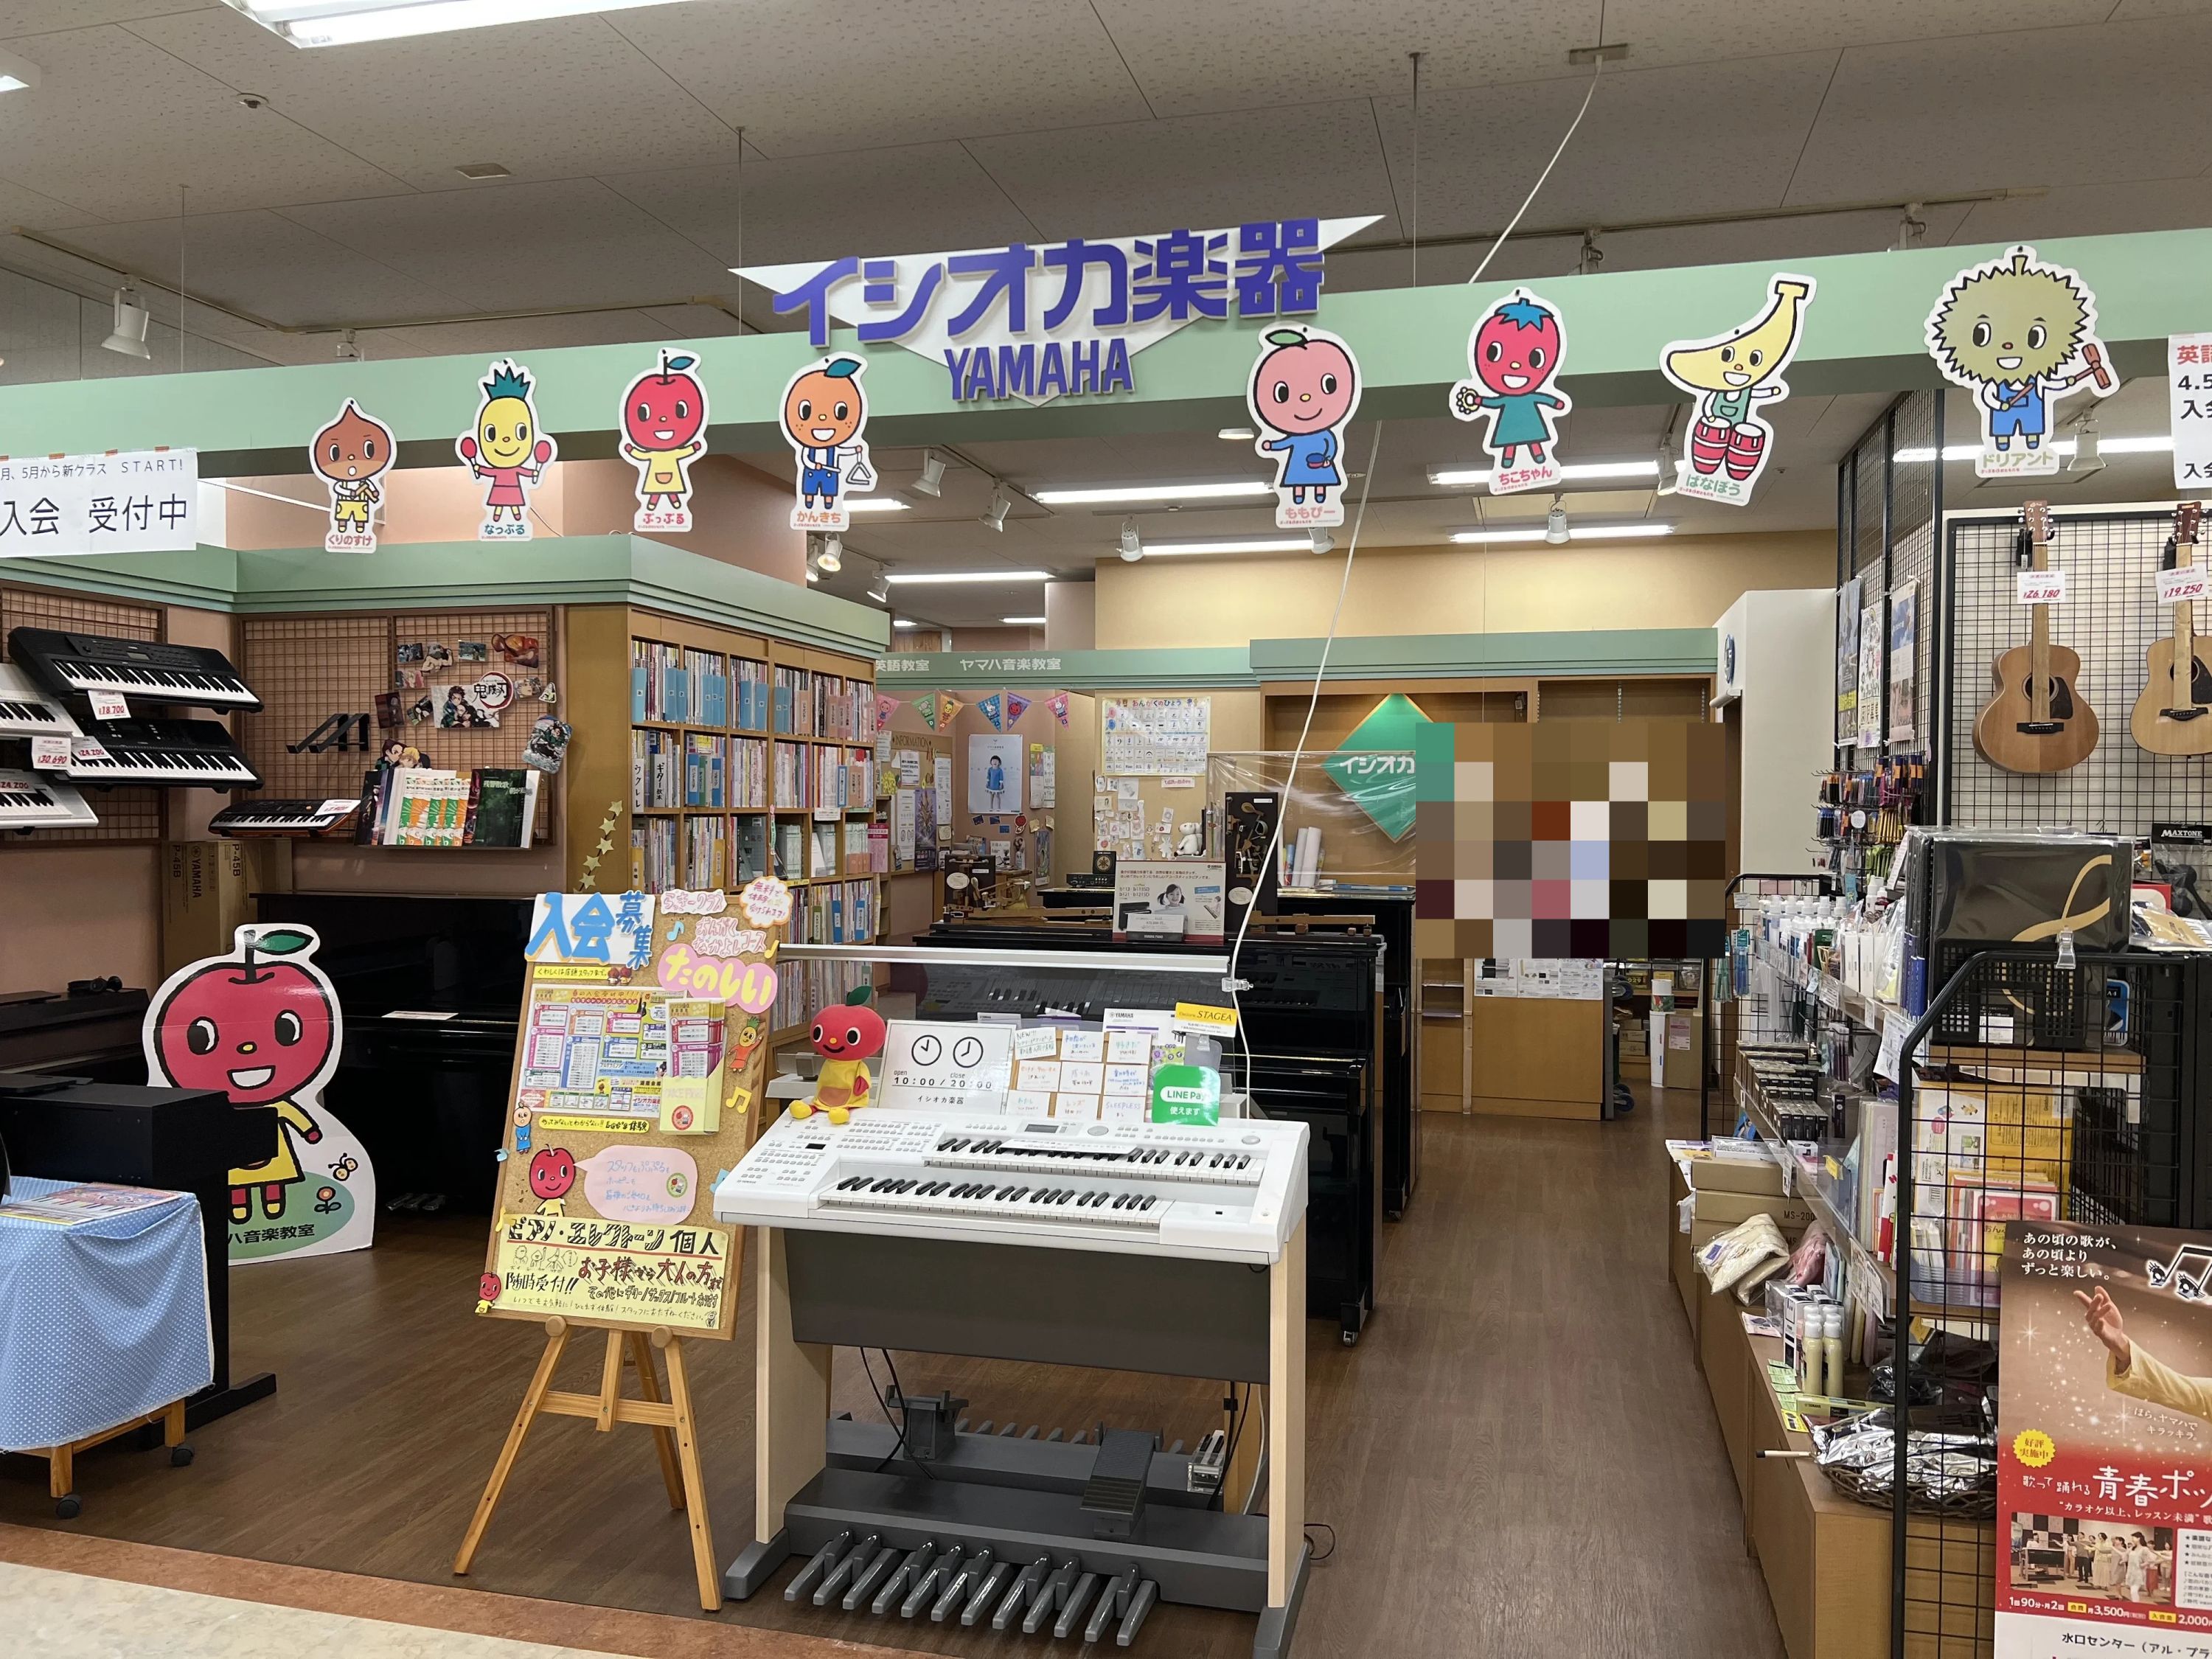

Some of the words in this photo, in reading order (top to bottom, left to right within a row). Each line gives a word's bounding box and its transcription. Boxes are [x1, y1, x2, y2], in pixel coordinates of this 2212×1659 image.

[773, 220, 1324, 348] イシオカ楽器
[944, 338, 1134, 401] YAMAHA
[1983, 451, 2053, 468] ドリアント
[1, 463, 106, 481] 月、5月から新クラス
[121, 459, 183, 473] START!
[1498, 465, 1553, 485] ちこちゃん
[1686, 474, 1740, 495] ばなぼう
[0, 498, 60, 536] 入会
[88, 493, 187, 533] 受付中
[796, 510, 841, 524] かんきち
[1285, 506, 1335, 518] ももぴー
[328, 535, 372, 546] くりのすけ
[875, 659, 930, 672] 英語教室
[960, 658, 1061, 671] ヤマハ音楽教室
[1133, 699, 1181, 707] おんがくのひょう
[894, 737, 931, 748] INFORMATION
[1340, 756, 1416, 773] イシオカ
[2161, 830, 2203, 838] MAXTONE
[172, 844, 181, 878] P-45B
[232, 843, 241, 877] P-45B
[192, 858, 201, 898] YAMAHA
[524, 891, 615, 963] 入会
[616, 890, 654, 970] 募集
[695, 917, 737, 936] おんがく
[741, 931, 766, 951] コース
[666, 947, 772, 1006] たのしい
[1197, 1010, 1233, 1021] STAGEA
[894, 1077, 935, 1086] 10:00
[950, 1080, 992, 1089] 20:00
[917, 1096, 964, 1105] イシオカ楽器
[1169, 1106, 1200, 1116] 使えます
[628, 1121, 647, 1131] 体験
[669, 1230, 719, 1255] 個人
[2023, 1233, 2117, 1250] あの頃の歌が、
[2022, 1247, 2088, 1262] あの頃より
[2021, 1262, 2110, 1281] ずっと楽しい。
[2025, 1438, 2045, 1448] 好評
[2020, 1448, 2048, 1459] 実施中
[2023, 1475, 2053, 1489] 歌って
[2056, 1481, 2091, 1495] 踊れる
